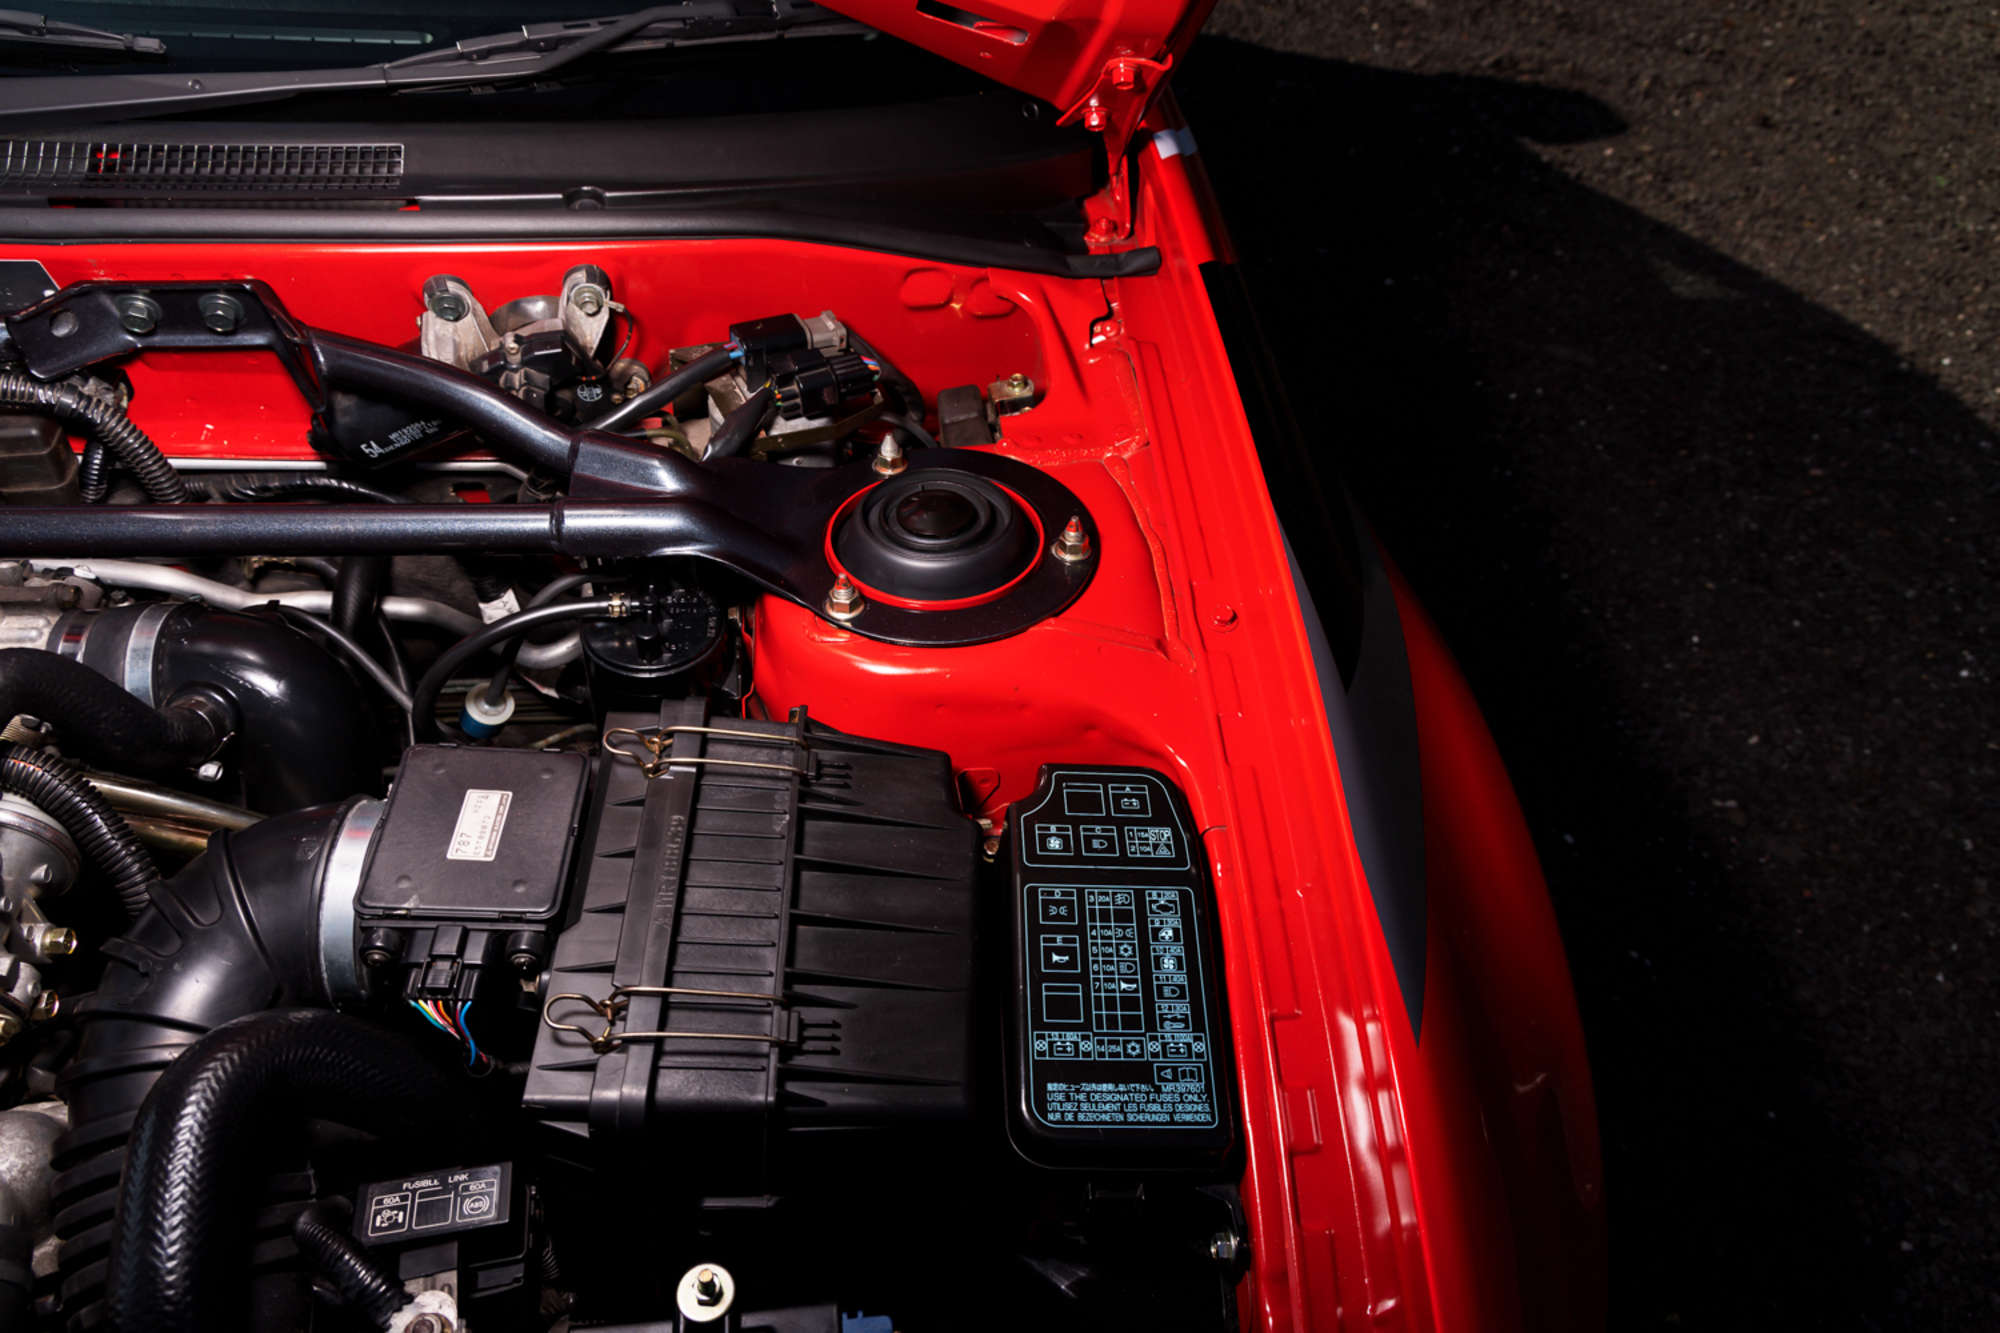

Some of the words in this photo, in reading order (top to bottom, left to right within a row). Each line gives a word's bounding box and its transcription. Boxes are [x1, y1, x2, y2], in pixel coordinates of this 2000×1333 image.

[1150, 829, 1170, 841] STOP
[1161, 1083, 1205, 1093] MR397601
[1047, 1093, 1066, 1101] USE
[1069, 1093, 1087, 1101] THE
[1090, 1093, 1147, 1102] DESIGNATED
[1149, 1093, 1180, 1102] FUSES
[1183, 1094, 1210, 1102] ONLY.
[1047, 1102, 1078, 1111] UTILISEZ
[1080, 1102, 1122, 1111] SEULEMENT
[1123, 1103, 1138, 1112] LES
[1140, 1103, 1173, 1112] FUSIBLES
[1047, 1112, 1061, 1121] NUR
[448, 1173, 469, 1184] LINK
[469, 1183, 486, 1191] 60A
[383, 1196, 400, 1205] 60A
